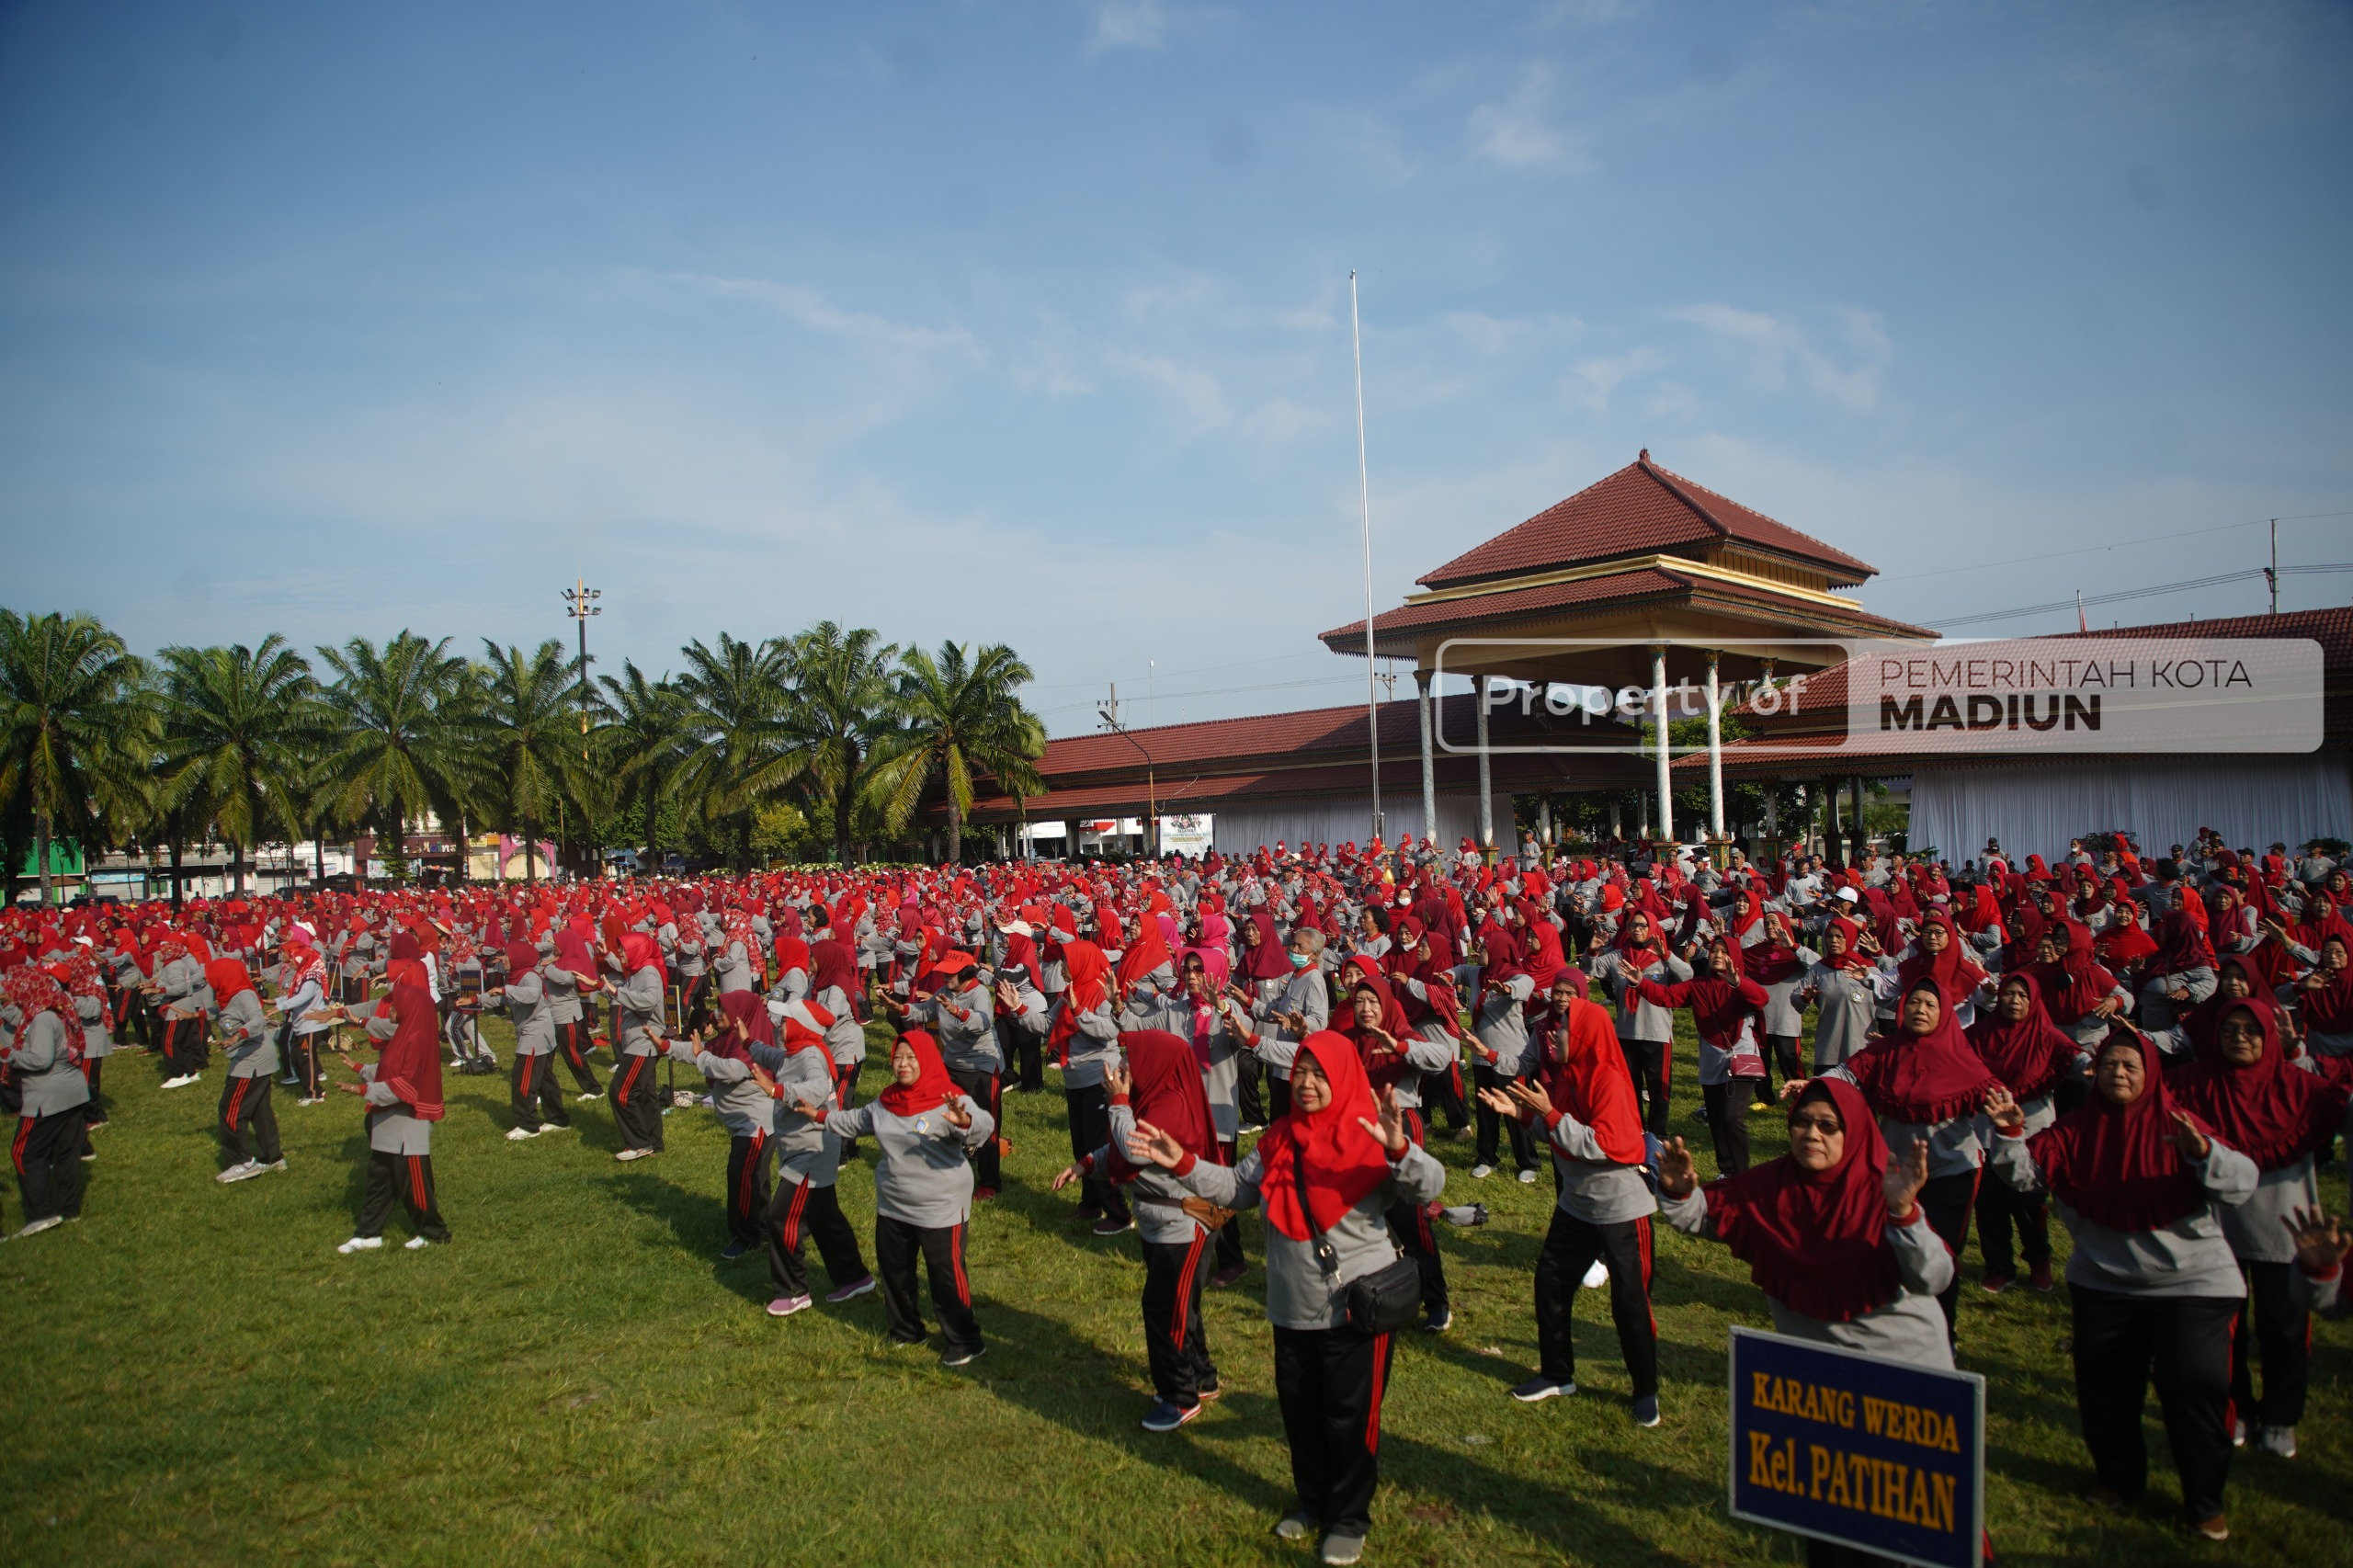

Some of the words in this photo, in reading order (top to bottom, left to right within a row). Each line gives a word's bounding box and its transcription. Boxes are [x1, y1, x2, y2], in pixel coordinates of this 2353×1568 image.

[1752, 1371, 1856, 1429] KARANG
[1862, 1395, 1961, 1454] WERDA
[1748, 1431, 1805, 1497] Kel.
[1810, 1445, 1958, 1533] PATIHAN
